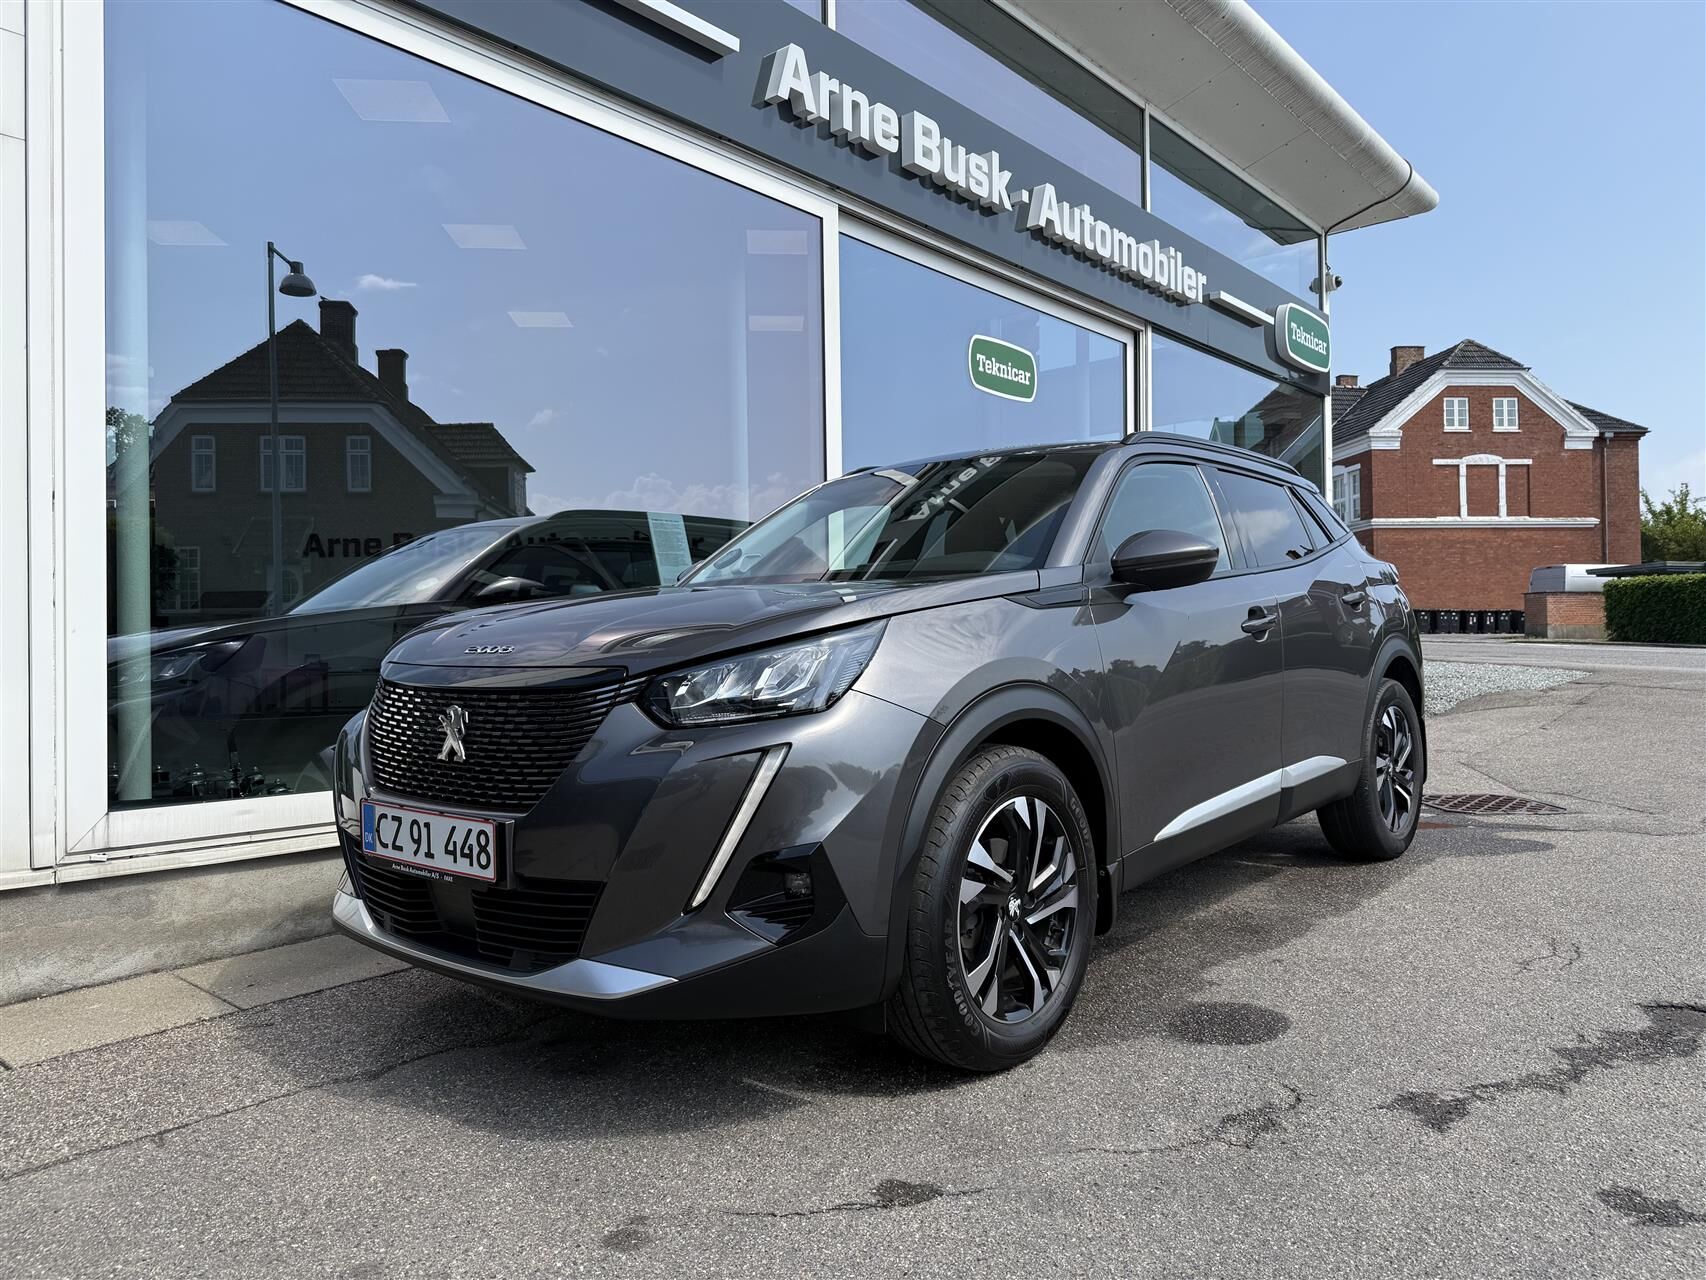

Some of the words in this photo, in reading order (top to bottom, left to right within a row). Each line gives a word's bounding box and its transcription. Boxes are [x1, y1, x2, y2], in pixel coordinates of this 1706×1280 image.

[768, 42, 900, 153] Arne
[905, 110, 1014, 212] Busk
[1030, 182, 1208, 304] Automobiler
[1290, 321, 1327, 355] Teknicar
[976, 353, 1031, 385] Teknicar
[302, 533, 382, 558] Arne
[364, 831, 374, 844] DK
[375, 812, 404, 852] CZ
[409, 818, 435, 860] 91
[444, 825, 492, 871] 448
